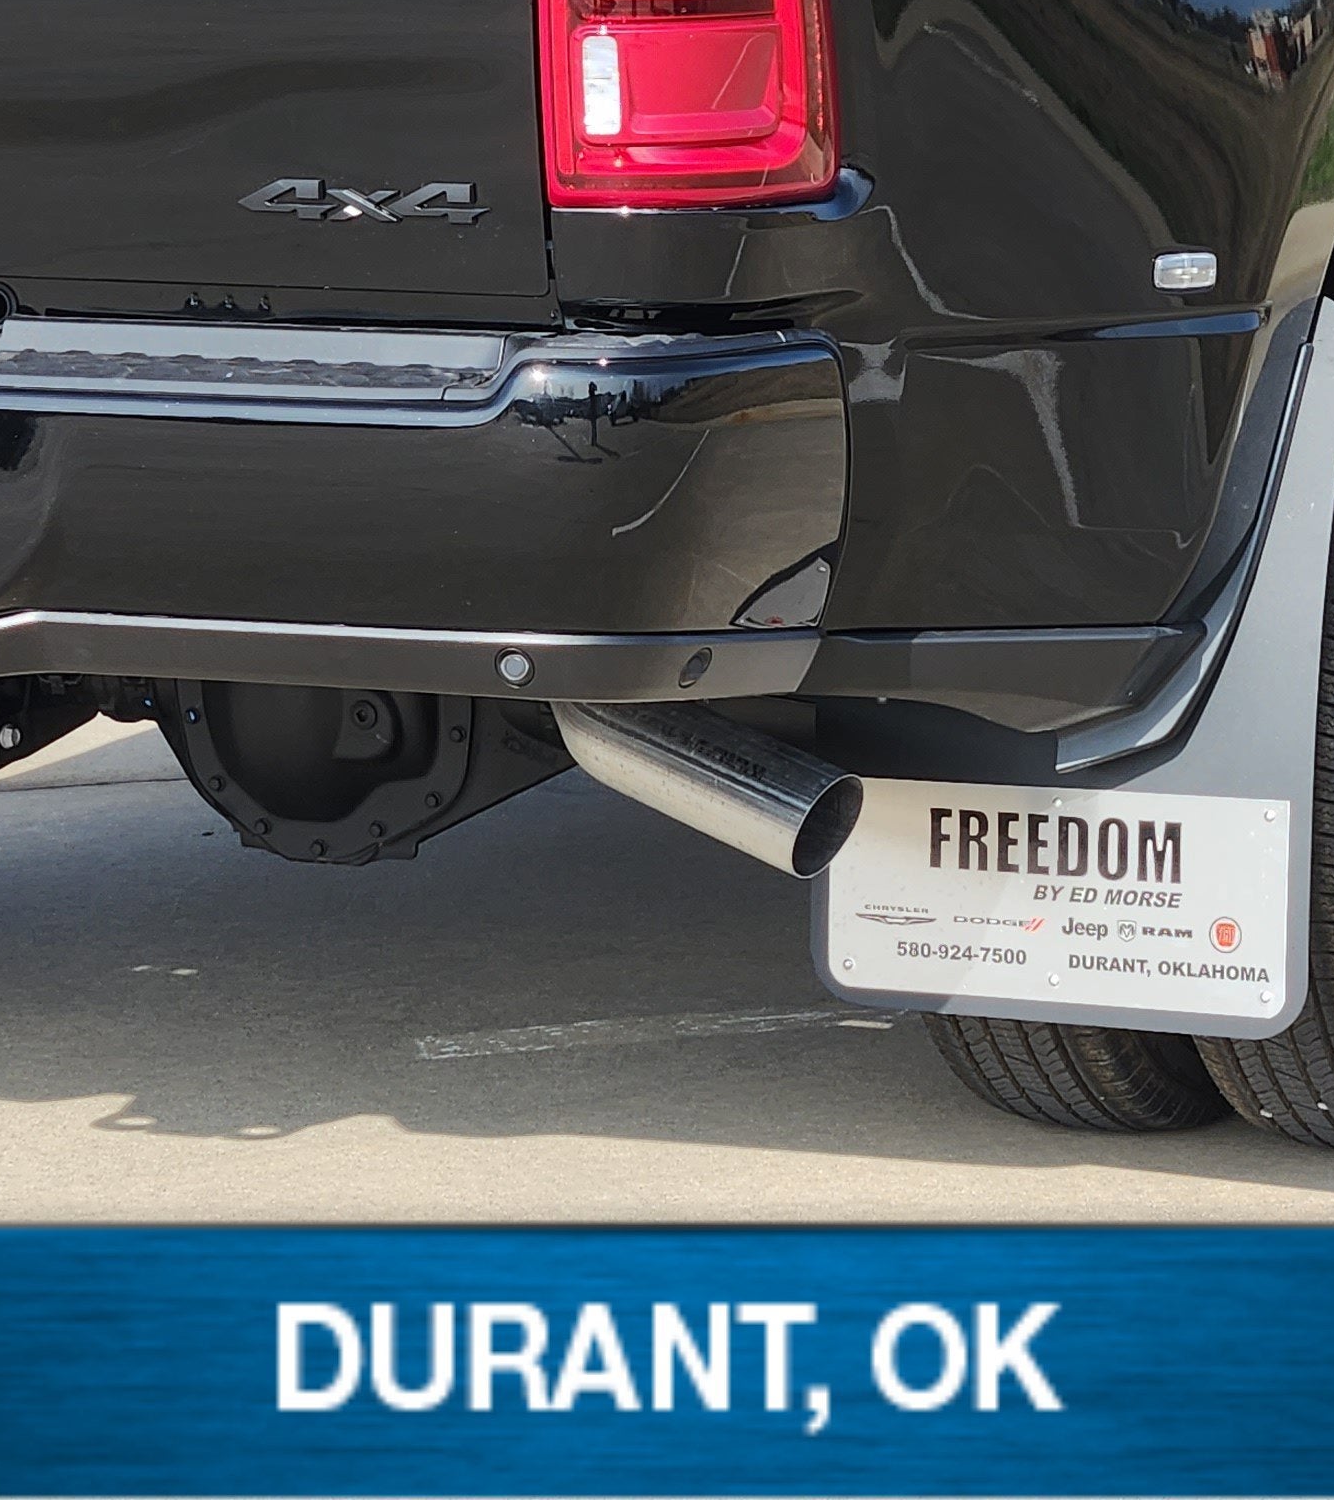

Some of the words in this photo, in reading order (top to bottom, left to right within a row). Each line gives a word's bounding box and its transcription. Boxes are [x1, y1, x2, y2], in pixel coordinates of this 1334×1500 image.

[928, 807, 1183, 884] FREEDOM
[864, 904, 930, 914] CHRYSLER
[1033, 884, 1065, 903] BY
[1069, 886, 1098, 904] ED
[1104, 888, 1183, 909] MORSE
[953, 915, 1030, 928] DODGE
[1061, 917, 1109, 940] Jeep
[1142, 926, 1193, 939] RAM
[896, 940, 1028, 966] 580-924-7500
[1068, 955, 1152, 978] DURANT,
[1158, 961, 1270, 984] OKLAHOMA
